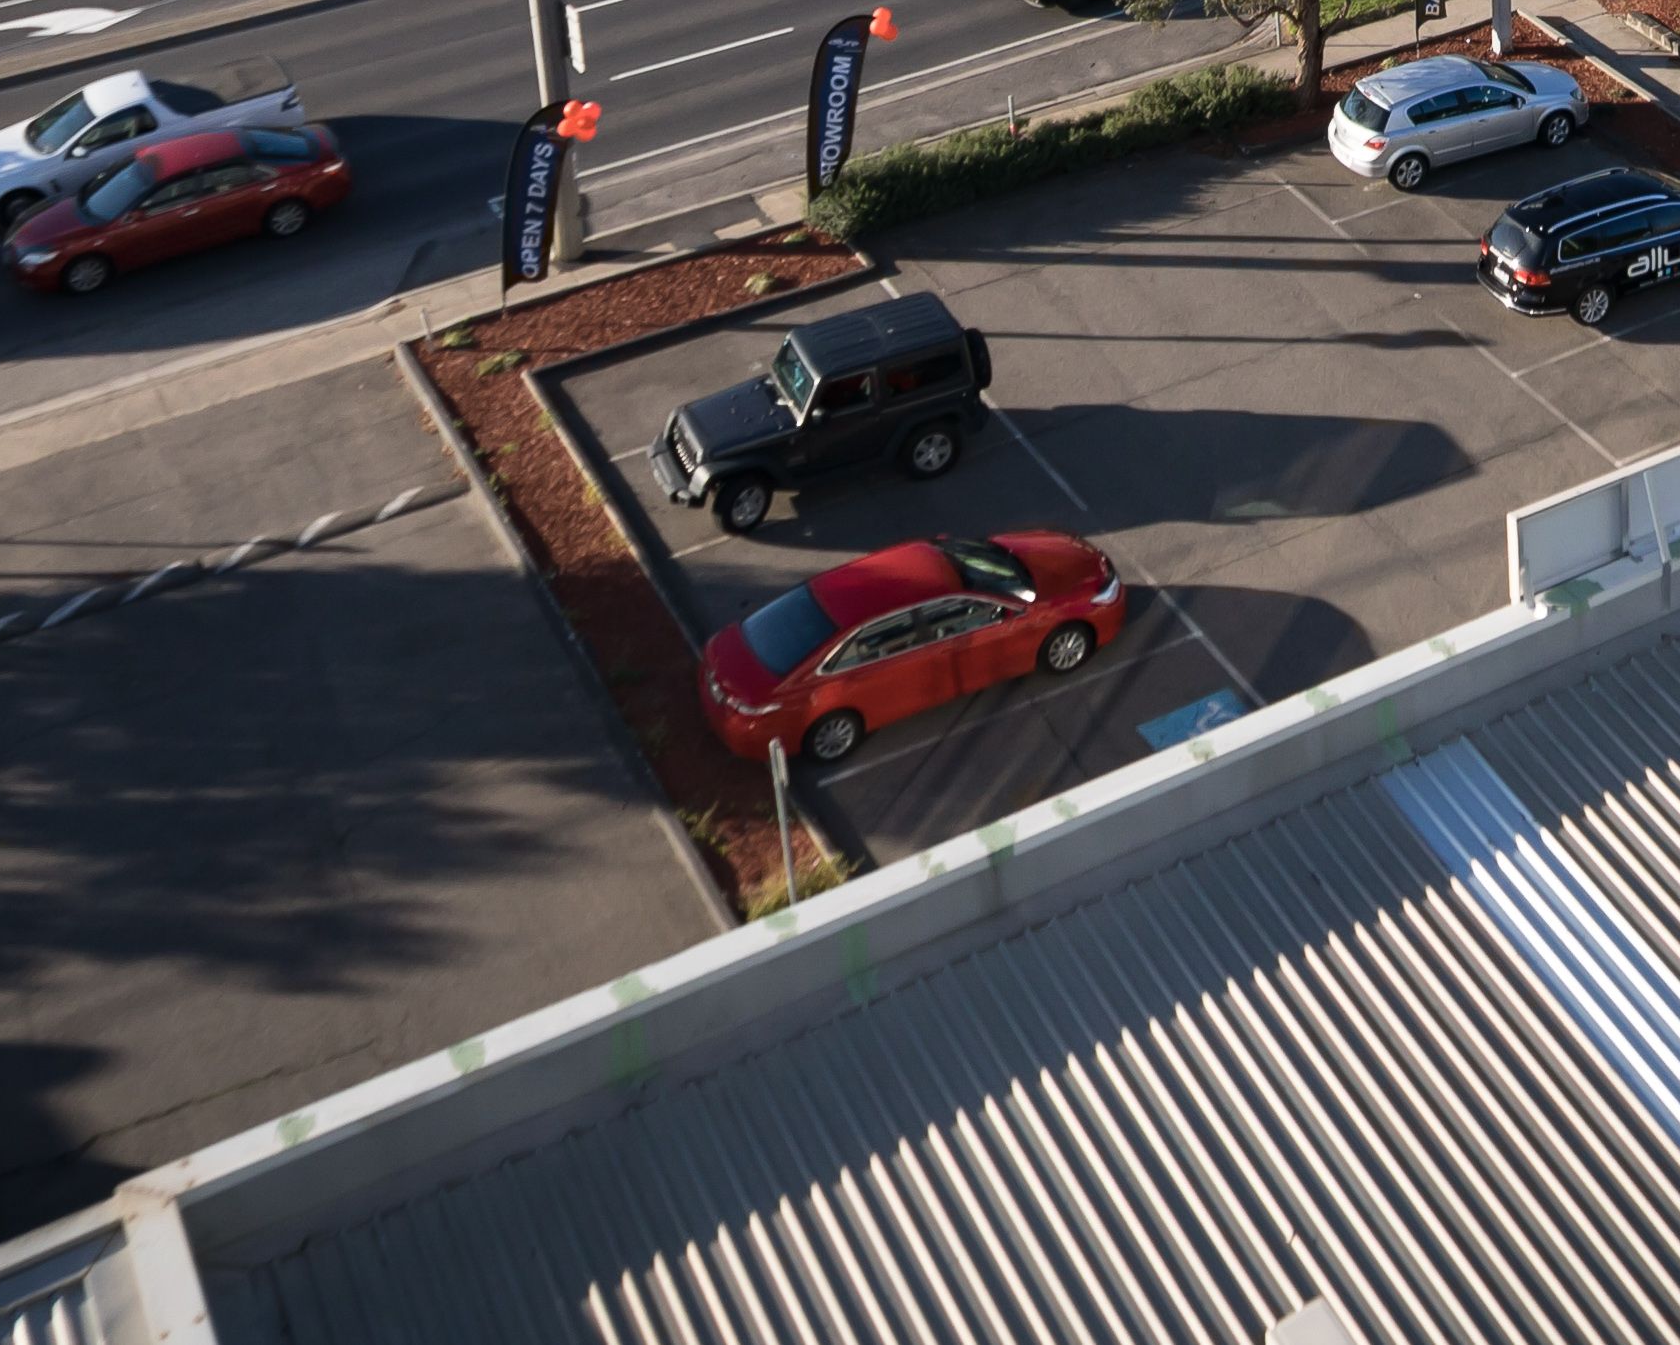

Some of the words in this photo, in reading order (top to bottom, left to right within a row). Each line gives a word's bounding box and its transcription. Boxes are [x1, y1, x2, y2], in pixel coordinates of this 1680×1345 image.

[821, 56, 853, 187] SHOWROOM
[528, 141, 554, 198] DAYS
[525, 202, 545, 213] 7
[521, 219, 544, 279] OPEN
